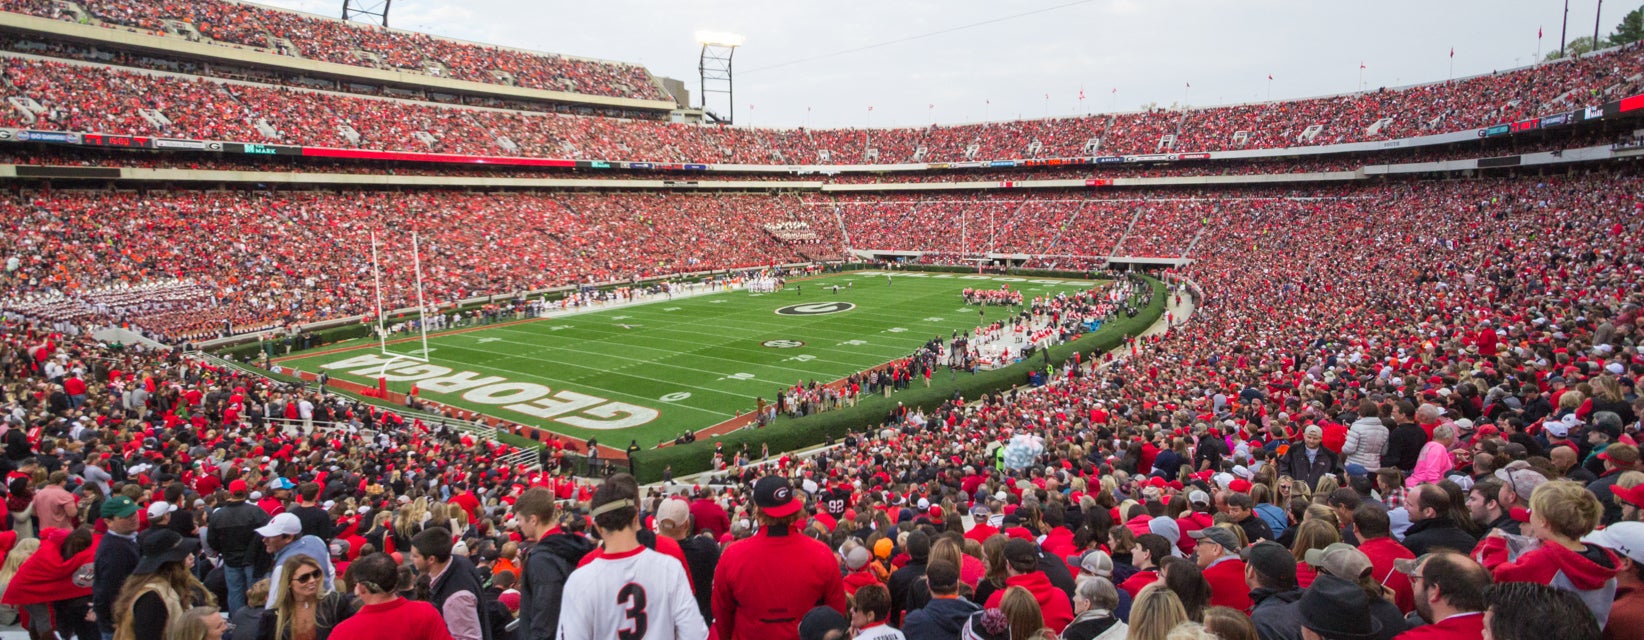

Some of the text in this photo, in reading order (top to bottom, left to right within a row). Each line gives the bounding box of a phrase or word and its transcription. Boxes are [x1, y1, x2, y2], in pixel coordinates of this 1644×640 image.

[319, 353, 661, 430] GEORGIA
[828, 499, 845, 514] 92
[616, 581, 648, 640] 3
